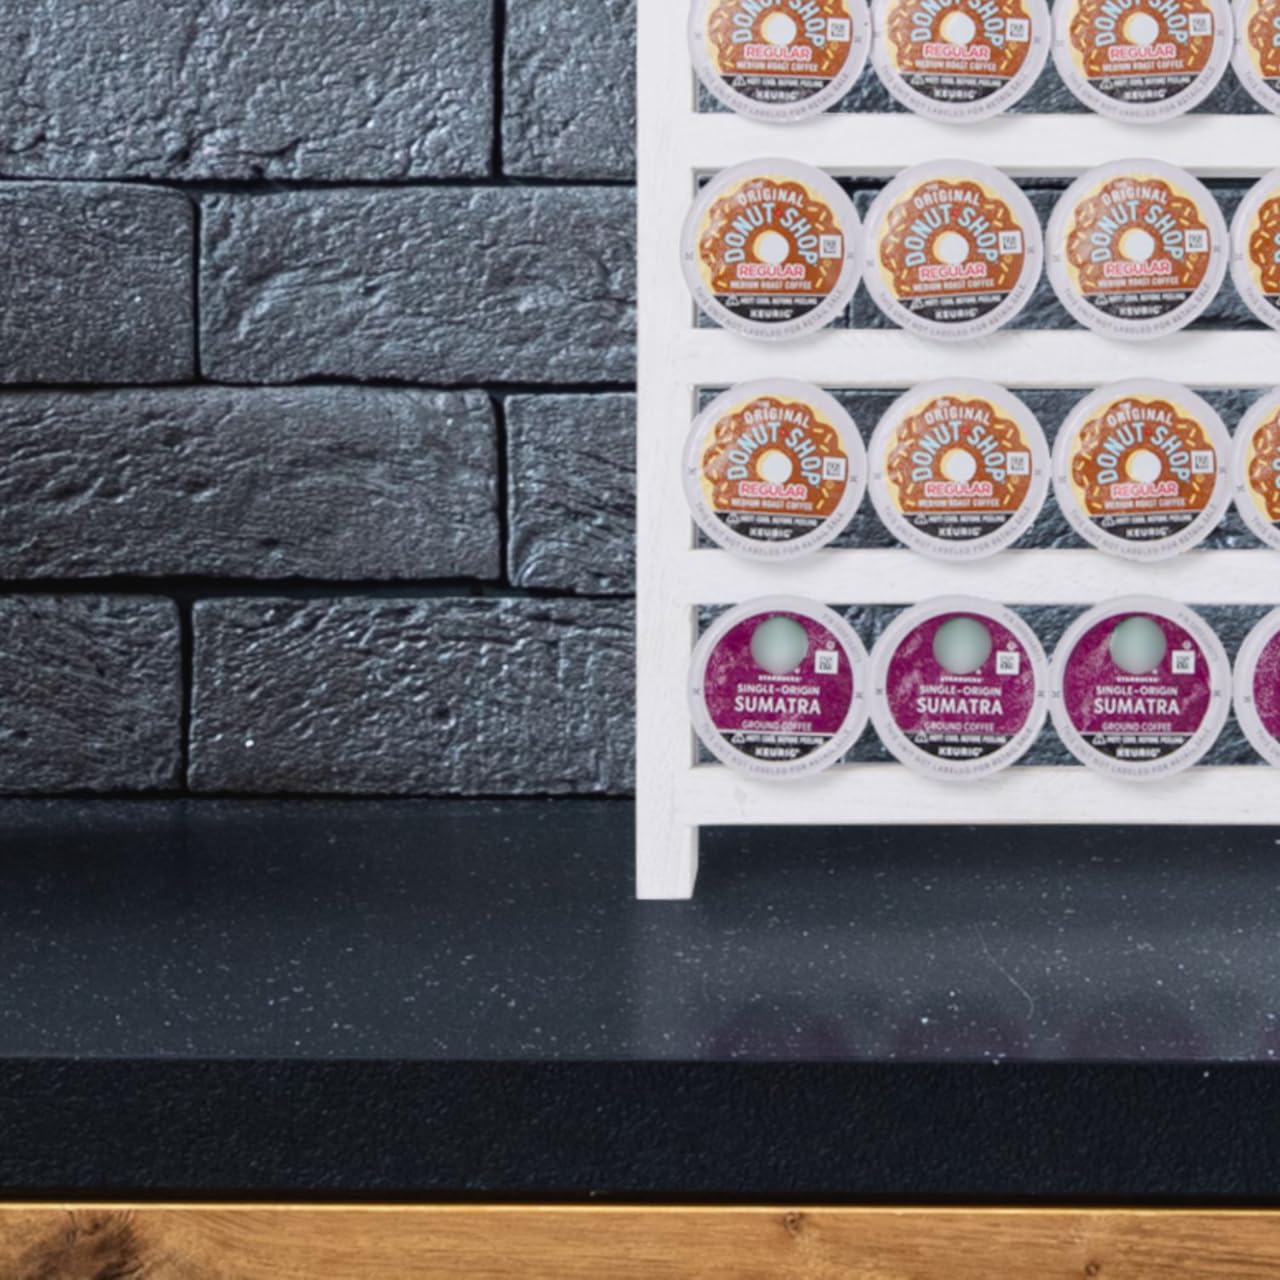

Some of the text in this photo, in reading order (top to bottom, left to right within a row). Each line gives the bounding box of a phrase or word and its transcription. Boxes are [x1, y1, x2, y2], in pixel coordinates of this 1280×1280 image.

[744, 45, 811, 61] REGULAR
[922, 44, 990, 61] REGULAR
[1108, 45, 1176, 62] REGULAR
[756, 90, 798, 100] KEURIG
[934, 89, 976, 99] KEURIG
[1124, 90, 1166, 100] KEURIG
[737, 186, 804, 208] ORIGINAL
[914, 188, 980, 209] ORIGINAL
[1101, 185, 1168, 205] ORIGINAL
[724, 202, 818, 264] DONUT SHOP
[904, 203, 999, 267] DONUT SHOP
[1090, 200, 1184, 263] DONUT SHOP
[737, 264, 804, 279] REGULAR
[918, 264, 986, 281] REGULAR
[1104, 261, 1171, 277] REGULAR
[750, 310, 792, 319] KEURIG
[935, 309, 977, 320] KEURIG
[1119, 306, 1161, 316] KEURIG
[743, 406, 810, 429] ORIGINAL
[924, 405, 990, 425] ORIGINAL
[1107, 406, 1173, 427] ORIGINAL
[727, 421, 821, 486] DONUT SHOP
[912, 420, 1005, 482] DONUT SHOP
[1097, 421, 1190, 484] DONUT SHOP
[738, 482, 806, 500] REGULAR
[924, 483, 992, 497] REGULAR
[1110, 483, 1178, 499] REGULAR
[750, 528, 792, 538] KEURIG
[938, 528, 981, 537] KEURIG
[1126, 527, 1168, 538] KEURIG
[737, 684, 820, 695] SINGLE-ORIGIN
[919, 685, 1001, 695] SINGLE-ORIGIN
[1096, 686, 1178, 695] SINGLE-ORIGIN
[734, 696, 821, 715] SUMATRA
[916, 697, 1003, 714] SUMATRA
[1094, 698, 1180, 714] SUMATRA
[742, 720, 812, 731] GROUND COFFEE
[924, 721, 994, 730] GROUND COFFEE
[1102, 722, 1171, 731] GROUND COFFEE
[755, 747, 800, 757] KEURIG
[938, 747, 983, 756] KEURIG
[1116, 748, 1160, 757] KEURIG
